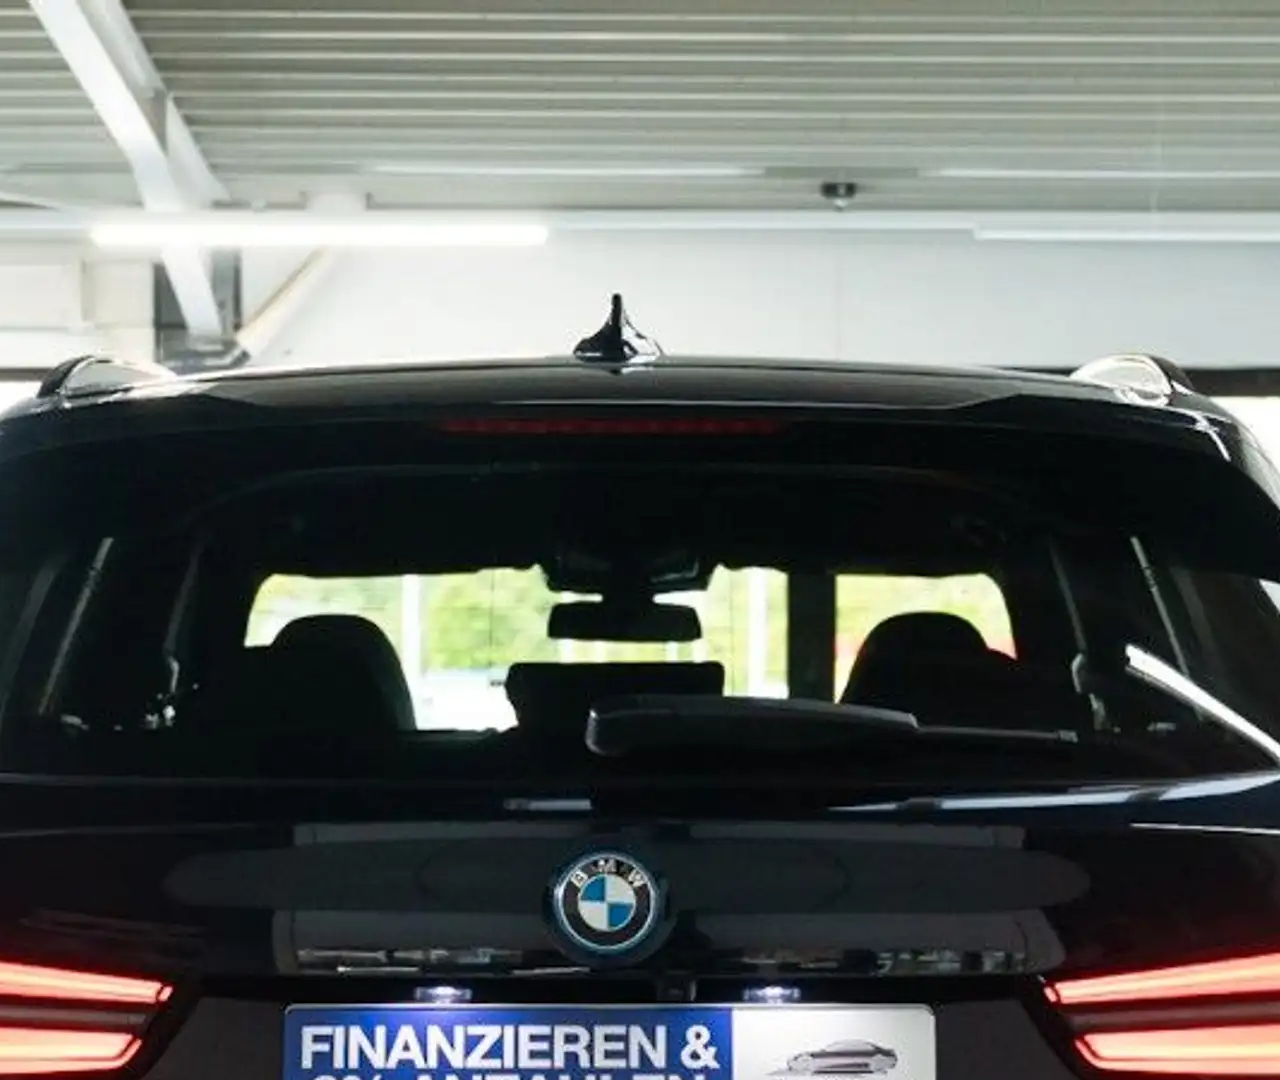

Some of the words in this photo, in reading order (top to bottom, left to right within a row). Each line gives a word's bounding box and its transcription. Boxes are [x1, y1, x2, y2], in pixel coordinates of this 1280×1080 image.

[571, 858, 647, 888] BMW
[300, 1024, 667, 1069] FINANZIEREN
[680, 1024, 720, 1070] &
